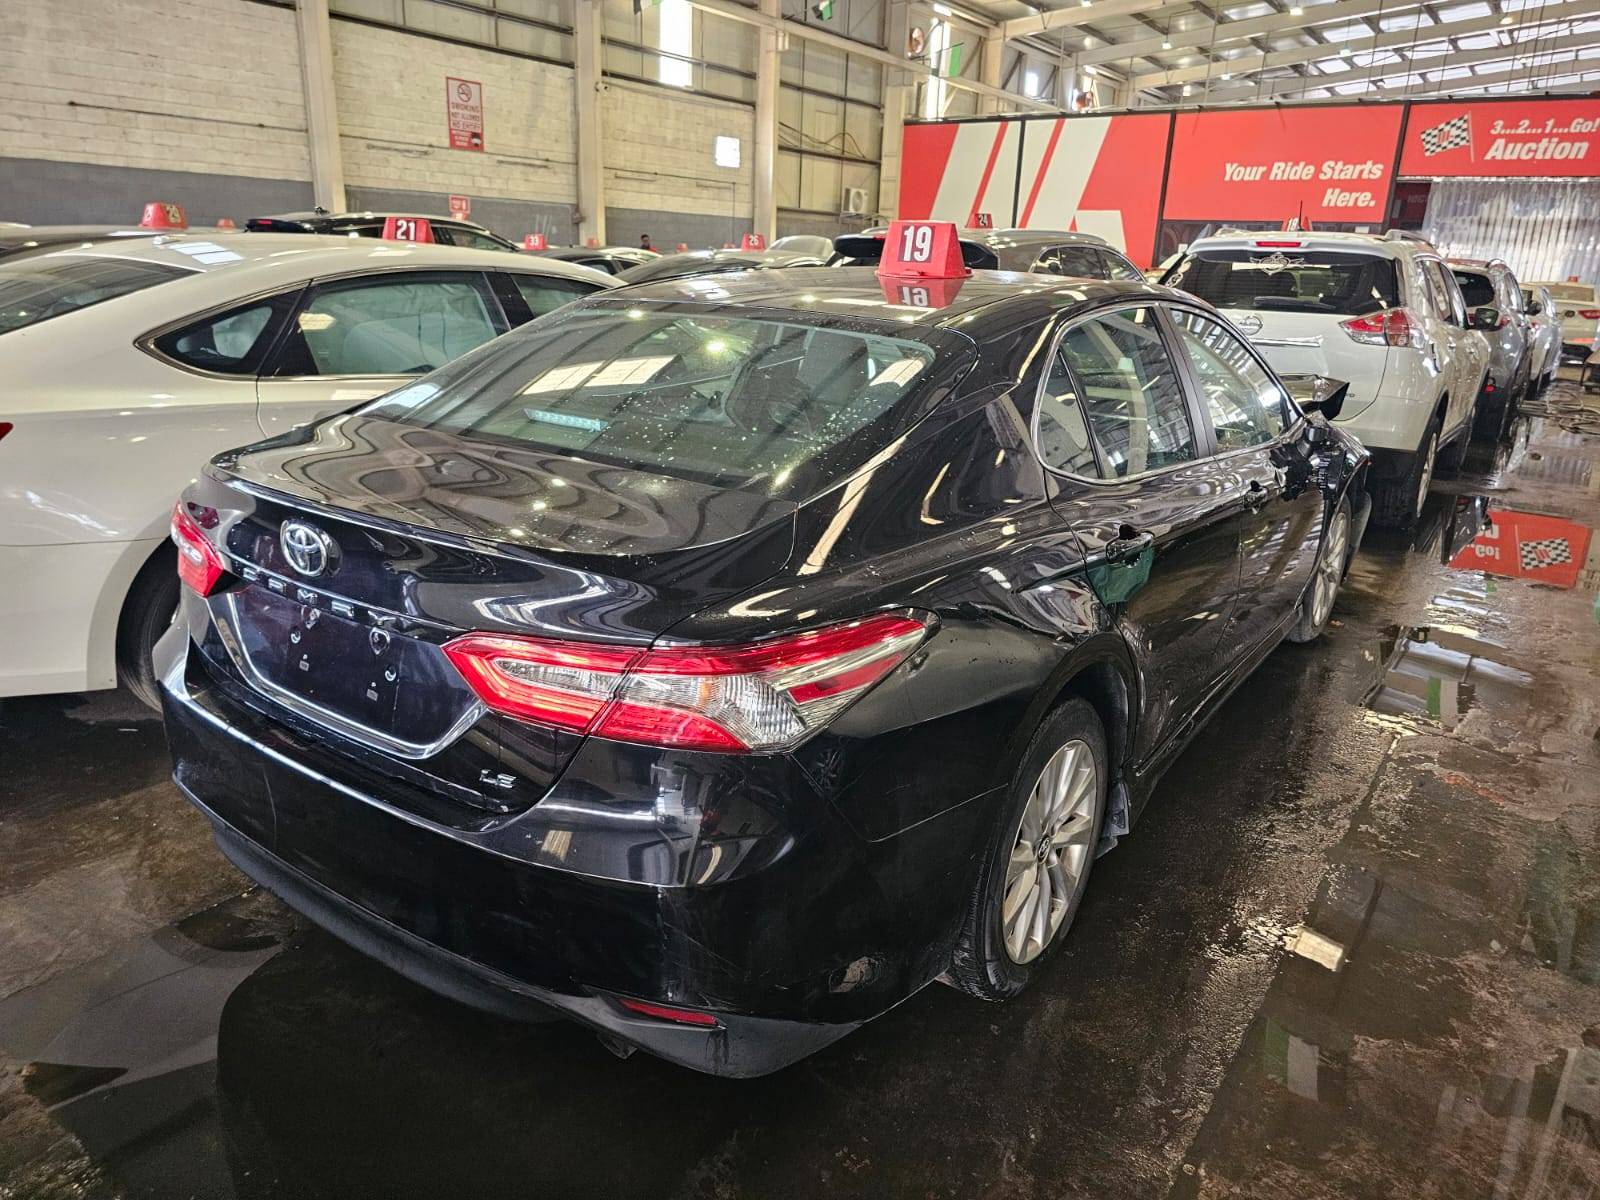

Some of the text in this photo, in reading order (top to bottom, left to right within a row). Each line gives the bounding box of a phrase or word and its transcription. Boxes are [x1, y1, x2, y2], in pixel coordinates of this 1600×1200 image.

[1484, 137, 1589, 160] Auction
[1224, 160, 1383, 181] Your Ride Starts
[1322, 188, 1376, 207] Here.
[396, 220, 415, 240] 21
[749, 235, 759, 245] 26
[903, 225, 932, 262] 19
[479, 769, 516, 788] LE
